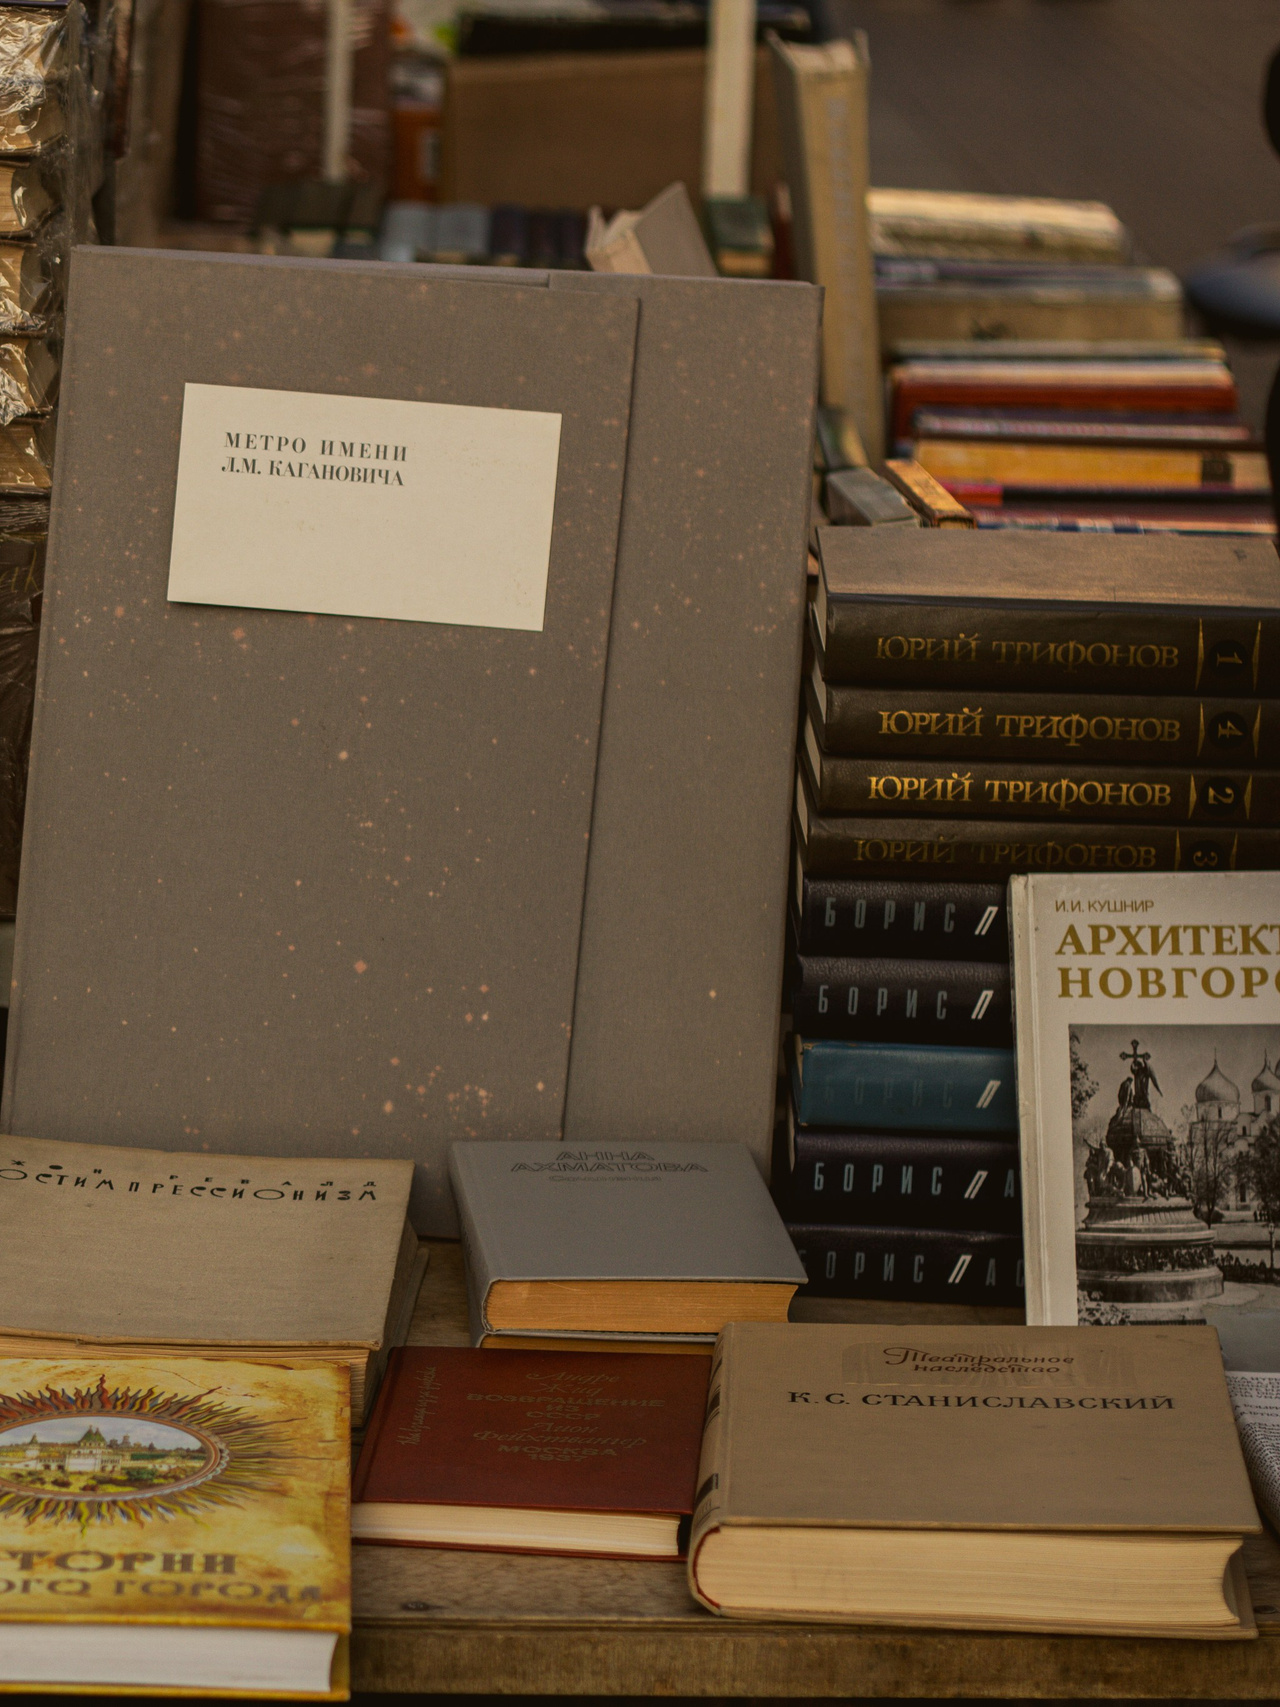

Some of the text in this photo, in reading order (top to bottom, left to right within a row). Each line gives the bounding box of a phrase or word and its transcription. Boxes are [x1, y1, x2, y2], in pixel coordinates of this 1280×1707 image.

[223, 431, 408, 462] МЕТРО ИМЕНИ
[268, 459, 406, 486] КАГАНОВИЧА
[875, 633, 1180, 673] ЮРИЙ ТРИФОНОВ
[1216, 650, 1245, 668] 1
[878, 706, 1181, 747] ЮРИЙ ТРИФОНОВ
[1217, 721, 1245, 739] 4
[867, 771, 1172, 811] ЮРИЙ ТРИФОНОВ
[1207, 786, 1236, 806] 2
[852, 833, 1158, 871] ЮРИЙ ТРИФОНОВ
[1192, 849, 1219, 867] 3
[824, 897, 957, 933] БОРИС
[1087, 900, 1155, 913] КУШНИР
[1057, 966, 1280, 999] НОВГОР
[818, 984, 948, 1020] БОРИС
[556, 1151, 656, 1161] АННА
[510, 1162, 709, 1173] АХМАТОВА
[813, 1162, 943, 1195] БОРИС
[881, 1346, 1075, 1367] Театральное
[525, 1371, 620, 1384] Андре
[913, 1362, 1061, 1375] наследство
[531, 1383, 603, 1397] Жид
[466, 1392, 666, 1407] ВОЗВРАЩЕНИЕ
[545, 1404, 580, 1412] ИЗ
[787, 1391, 1177, 1410] К. С. СТАНИСЛАВСКИЙ
[525, 1411, 601, 1421] СССР
[498, 1444, 618, 1456] МОСКВА
[527, 1453, 589, 1463] 1937
[113, 1578, 325, 1605] ГОРОДА
